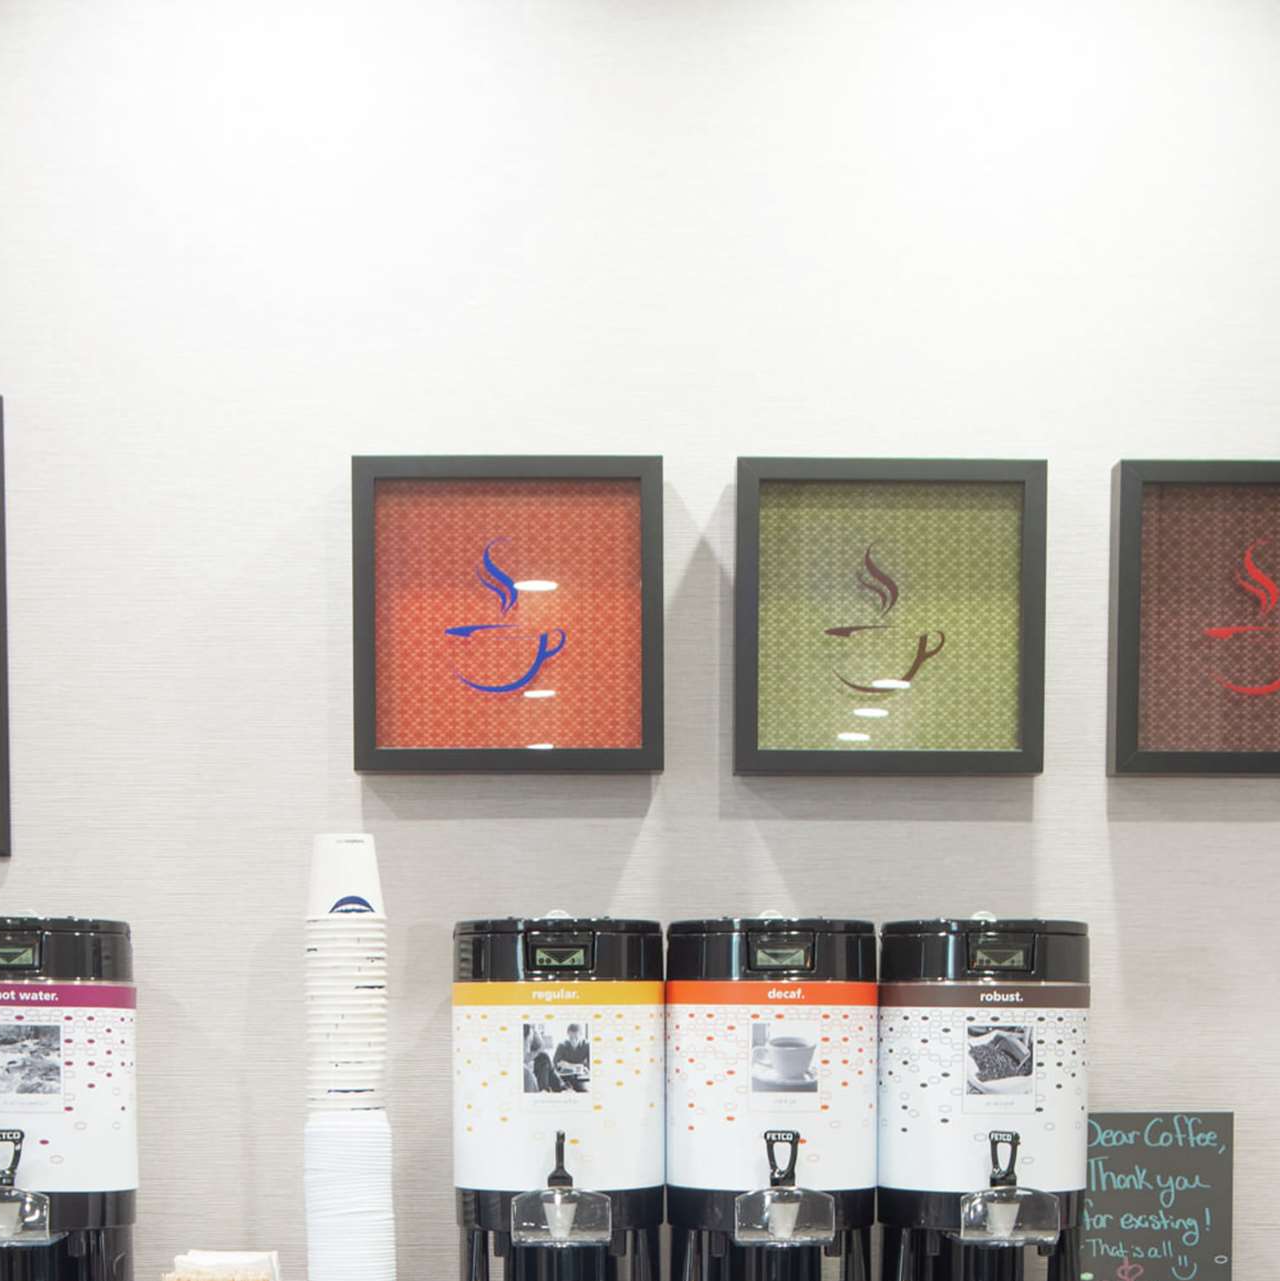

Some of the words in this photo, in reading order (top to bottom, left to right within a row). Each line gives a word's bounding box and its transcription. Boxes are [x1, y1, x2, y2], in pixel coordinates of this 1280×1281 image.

[19, 989, 59, 1002] water.
[531, 987, 580, 1003] regular.
[767, 987, 806, 1001] decaf.
[979, 989, 1024, 1003] robust.
[766, 1132, 794, 1142] FETCO
[990, 1132, 1013, 1142] FETCO
[1087, 1118, 1141, 1148] Dear
[1144, 1114, 1227, 1155] Coffee,
[1087, 1155, 1154, 1192] Thank
[1156, 1173, 1212, 1208] you
[1083, 1198, 1114, 1231] for
